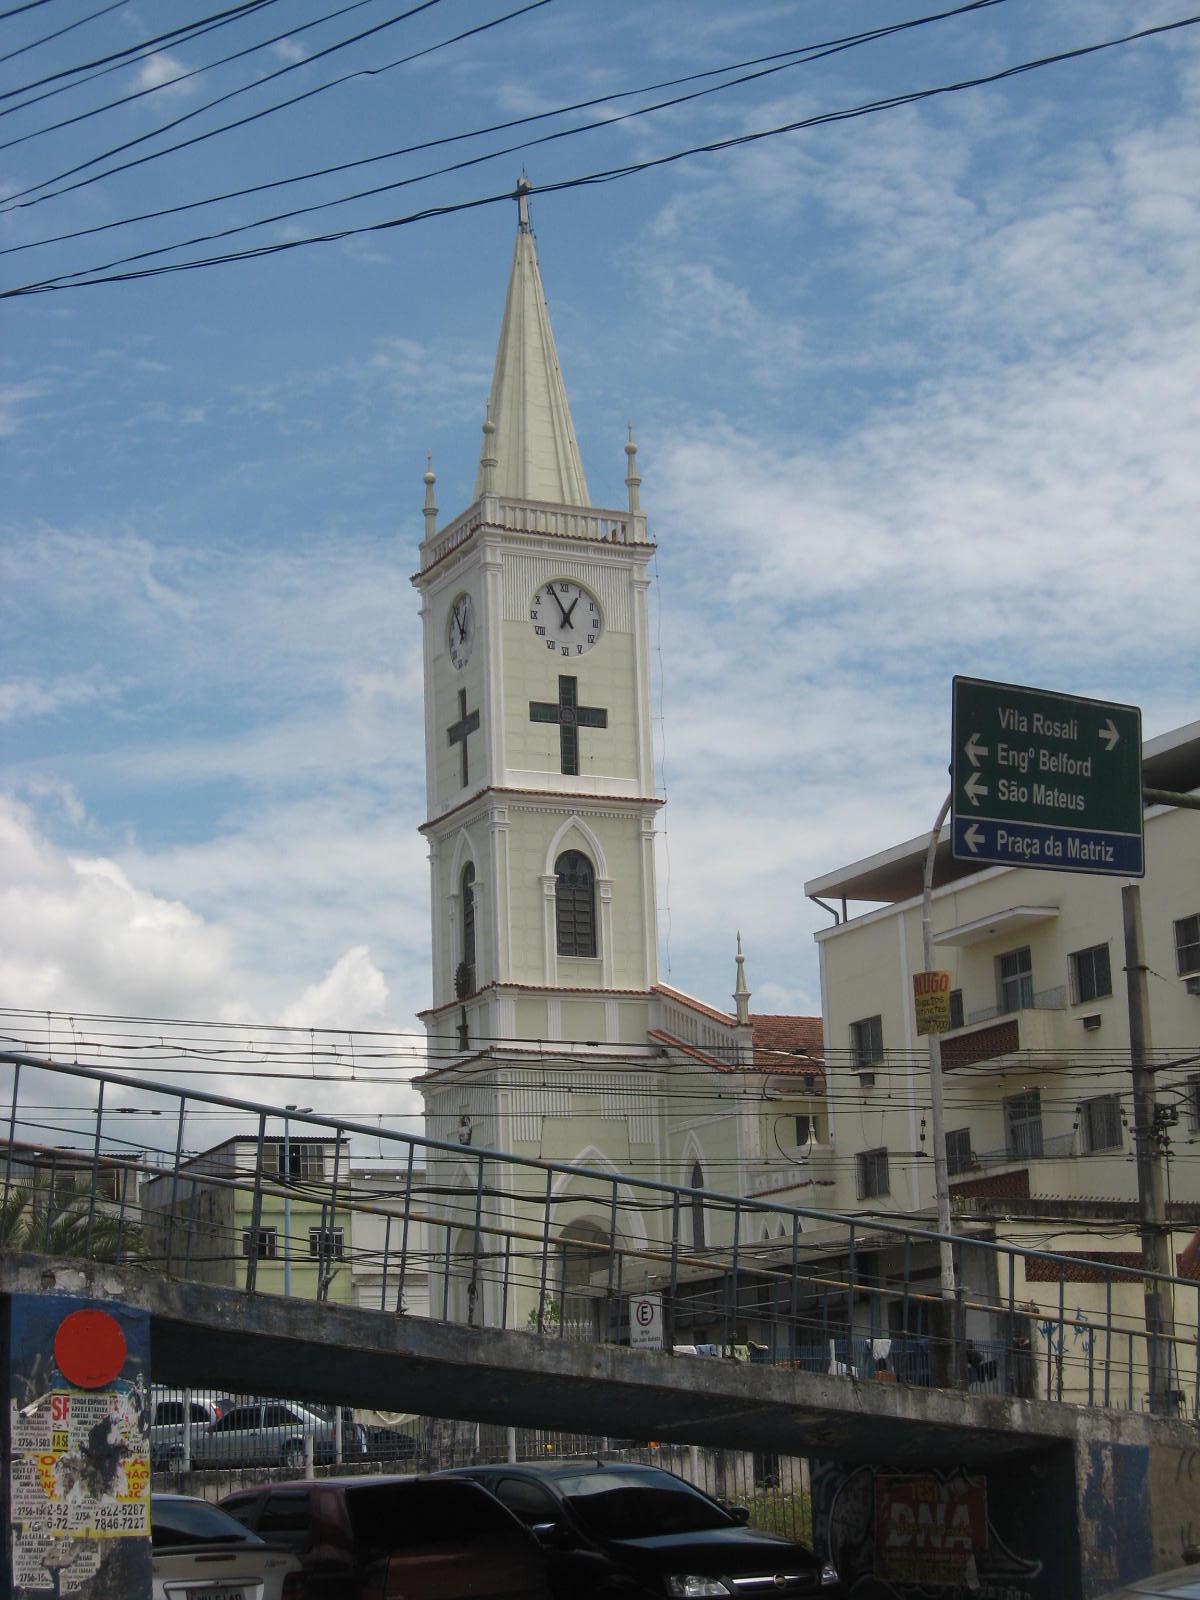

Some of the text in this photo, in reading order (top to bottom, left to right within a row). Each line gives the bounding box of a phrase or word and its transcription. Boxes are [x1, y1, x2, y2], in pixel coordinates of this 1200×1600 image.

[997, 706, 1078, 741] Vila Rosali
[1039, 749, 1092, 777] Belford
[998, 779, 1085, 811] São Mateus
[997, 830, 1114, 862] Praça da Matriz
[641, 1306, 648, 1321] E
